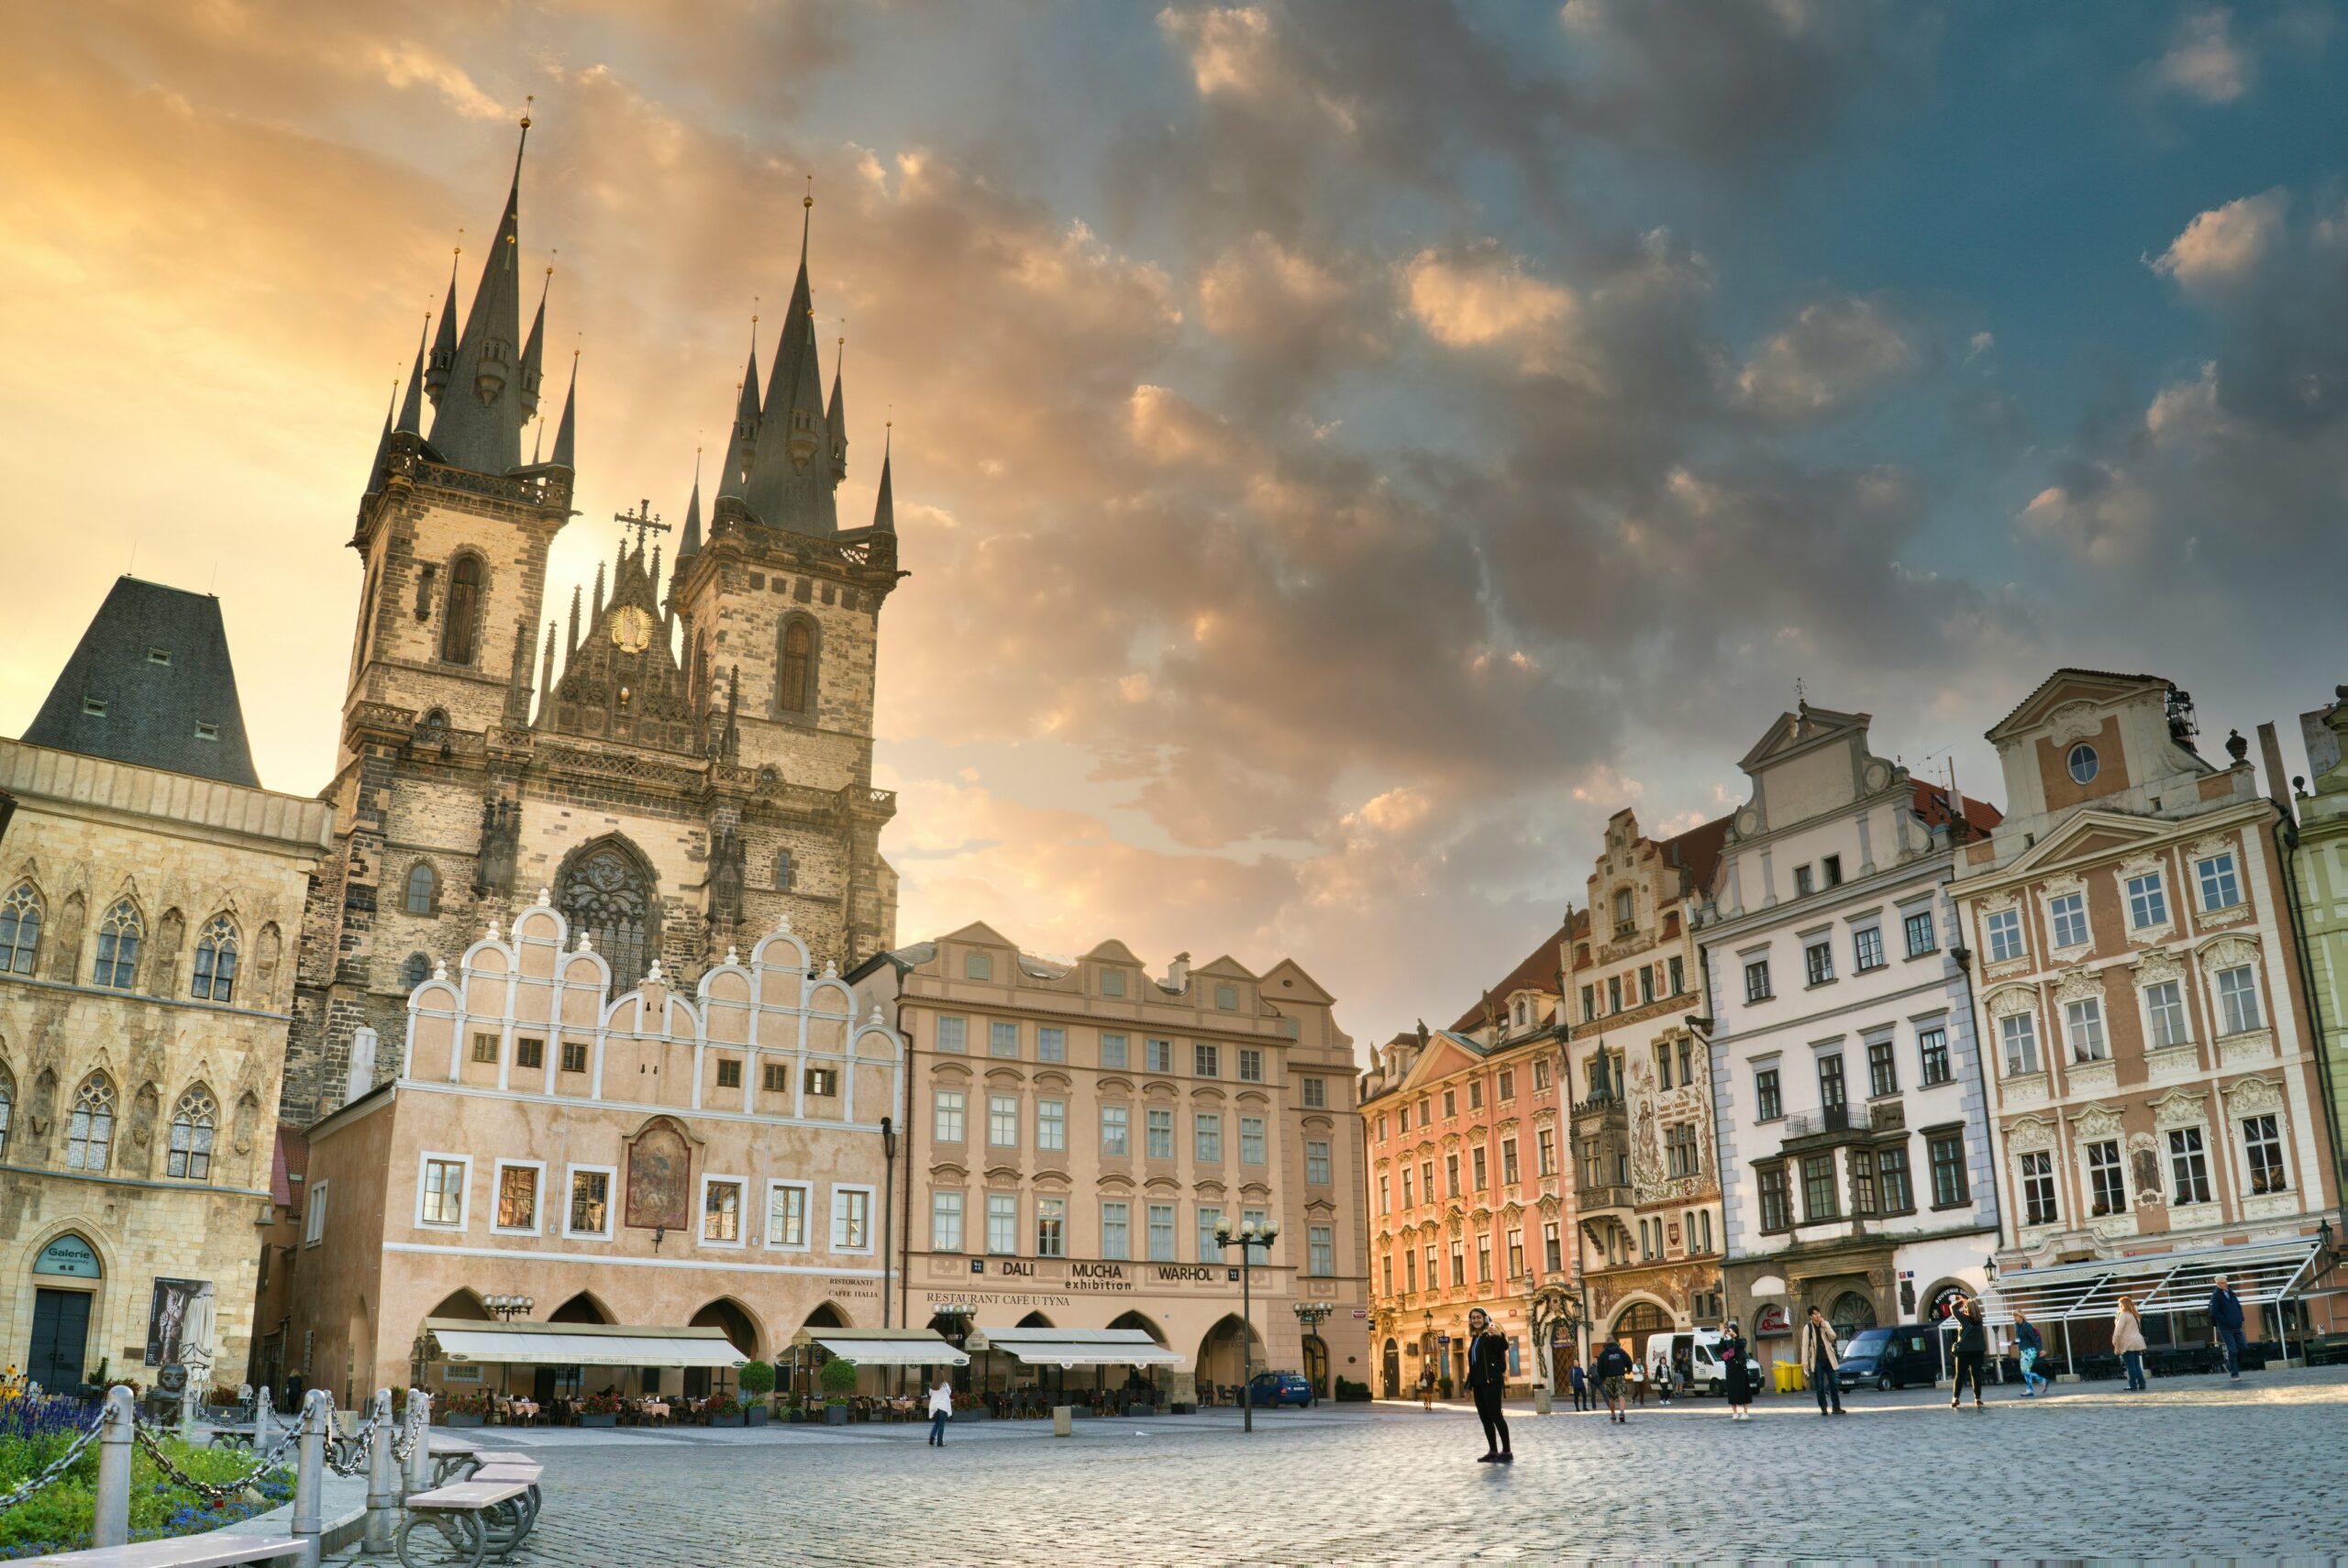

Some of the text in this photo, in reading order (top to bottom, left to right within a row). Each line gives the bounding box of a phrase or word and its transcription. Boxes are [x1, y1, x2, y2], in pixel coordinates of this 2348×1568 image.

[48, 1248, 91, 1259] Galerie
[1072, 1264, 1122, 1279] MUCHA
[1158, 1266, 1213, 1281] WARHOL
[829, 1277, 874, 1286] RISTORANTE
[1065, 1279, 1131, 1290] exhibition
[828, 1289, 878, 1298] CAFFE ITALIA
[926, 1292, 1000, 1304] RESTAURANT
[1032, 1296, 1040, 1306] U
[1934, 1287, 1959, 1304] SOUVENIR
